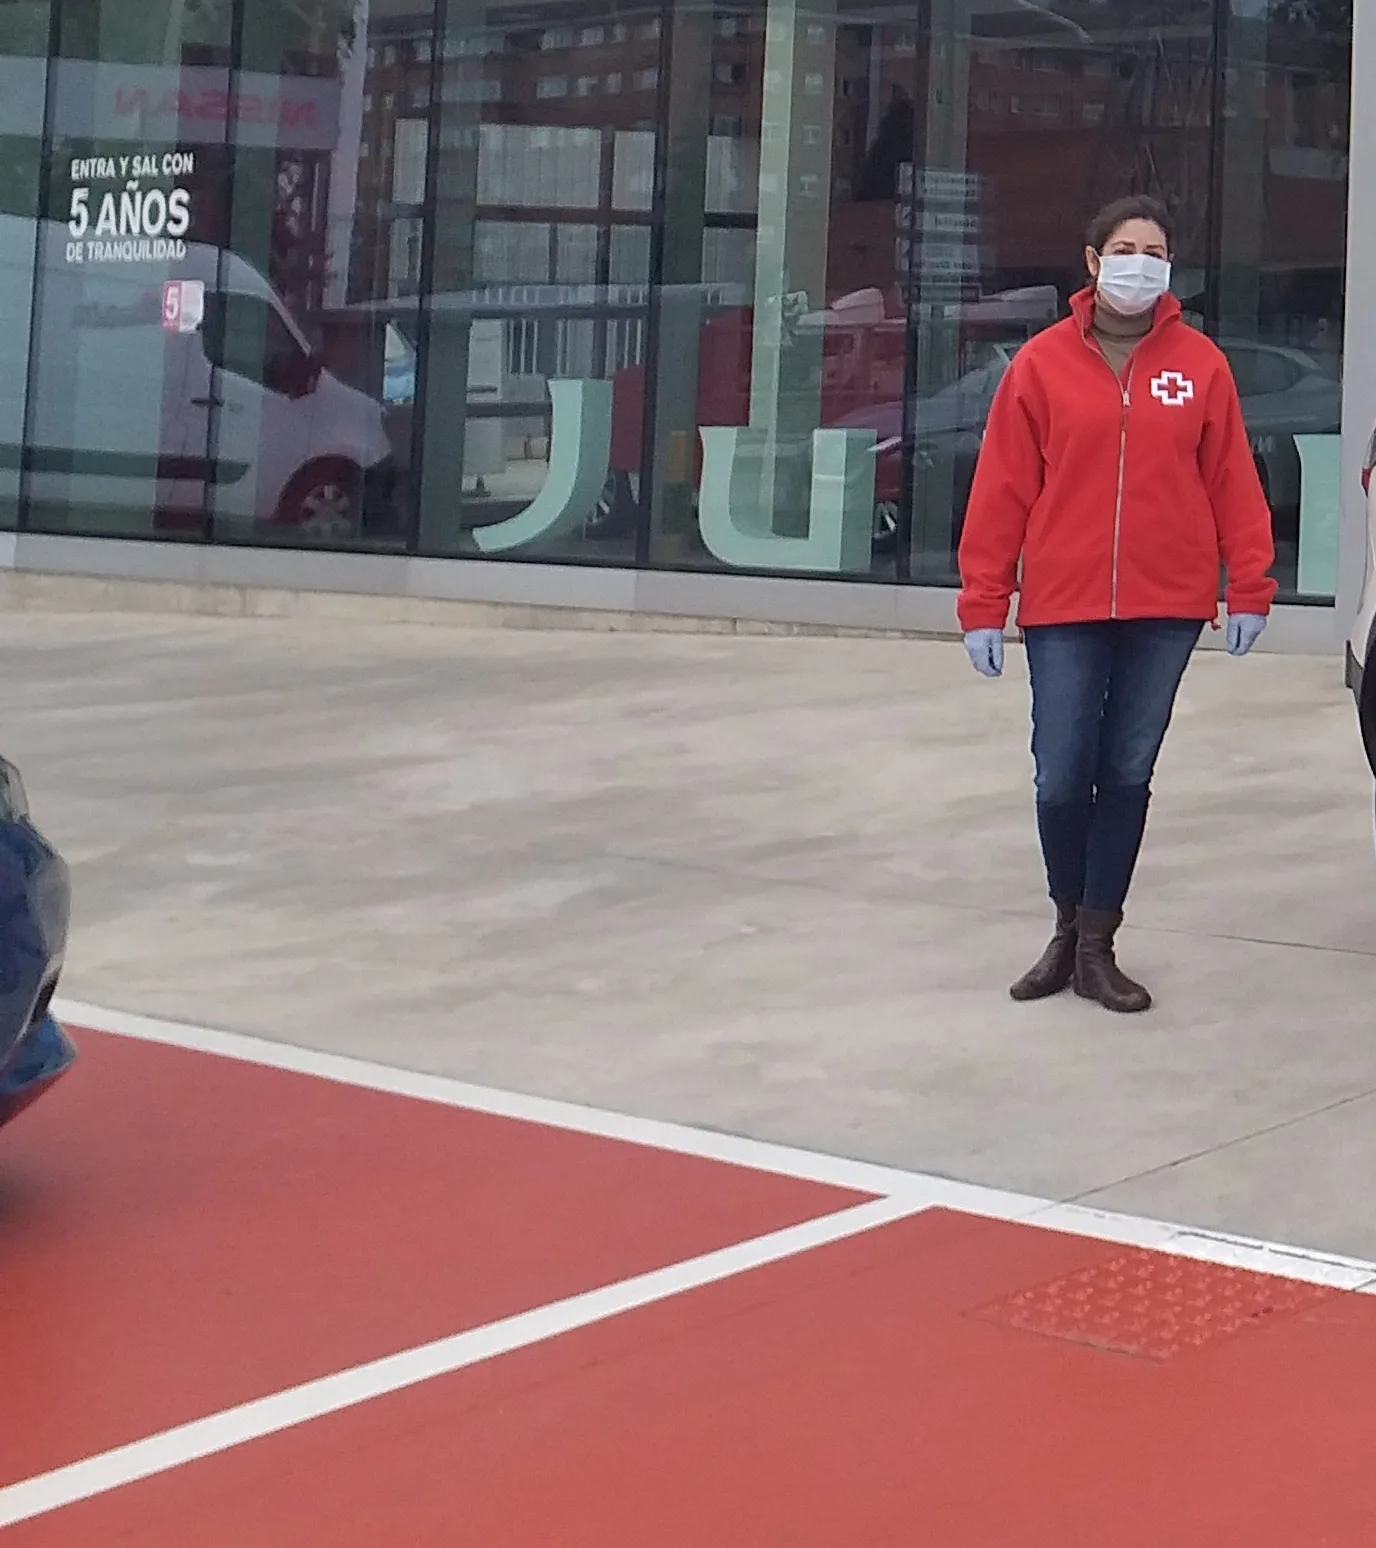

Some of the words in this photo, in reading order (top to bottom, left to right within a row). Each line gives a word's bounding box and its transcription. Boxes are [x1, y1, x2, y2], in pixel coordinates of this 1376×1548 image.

[71, 157, 116, 181] ENTRA
[119, 156, 129, 177] Y
[132, 154, 159, 177] SAL
[162, 152, 194, 175] CON
[68, 187, 89, 238] 5
[95, 180, 191, 237] AÑOS
[66, 242, 84, 263] DE
[87, 239, 187, 263] TRANQUILIDAD
[165, 286, 180, 320] 5
